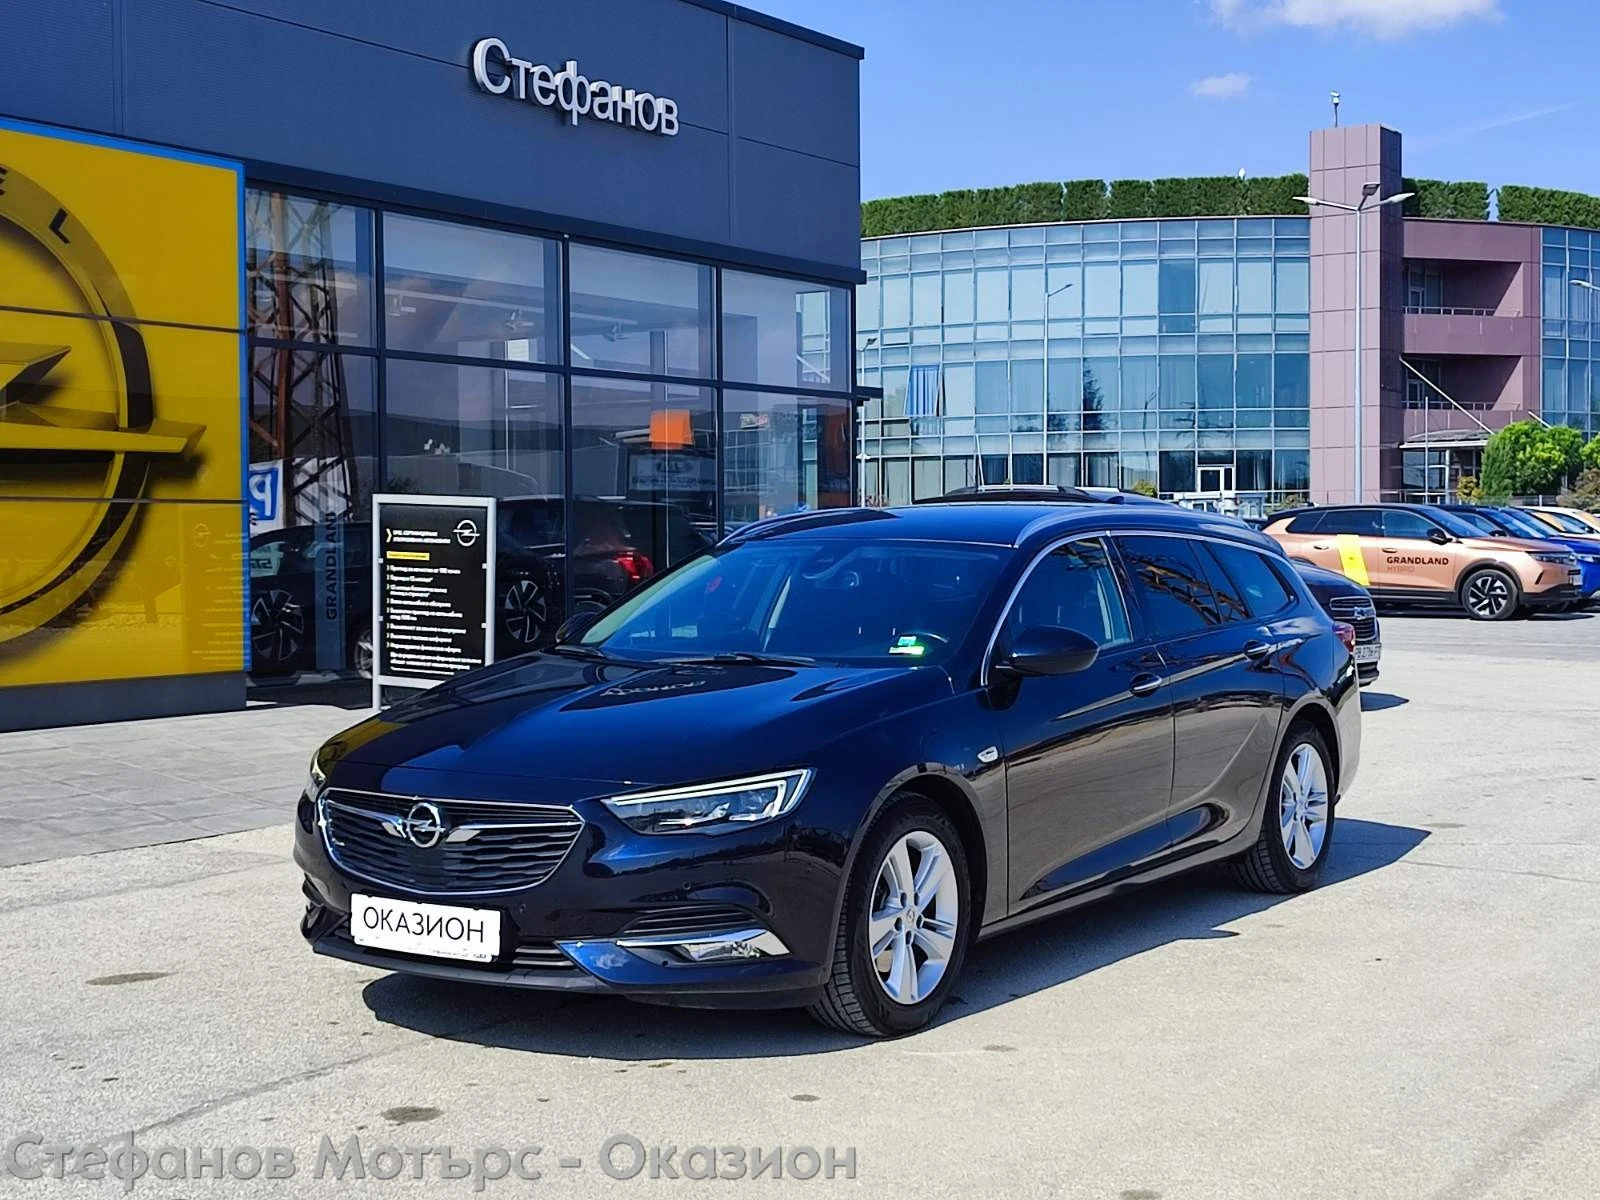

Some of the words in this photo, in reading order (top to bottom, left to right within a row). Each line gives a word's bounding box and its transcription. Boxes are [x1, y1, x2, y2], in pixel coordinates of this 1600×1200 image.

[473, 37, 679, 136] Стефанов
[1386, 556, 1449, 565] GRANDLAND
[363, 906, 484, 943] ОКАЗИОН
